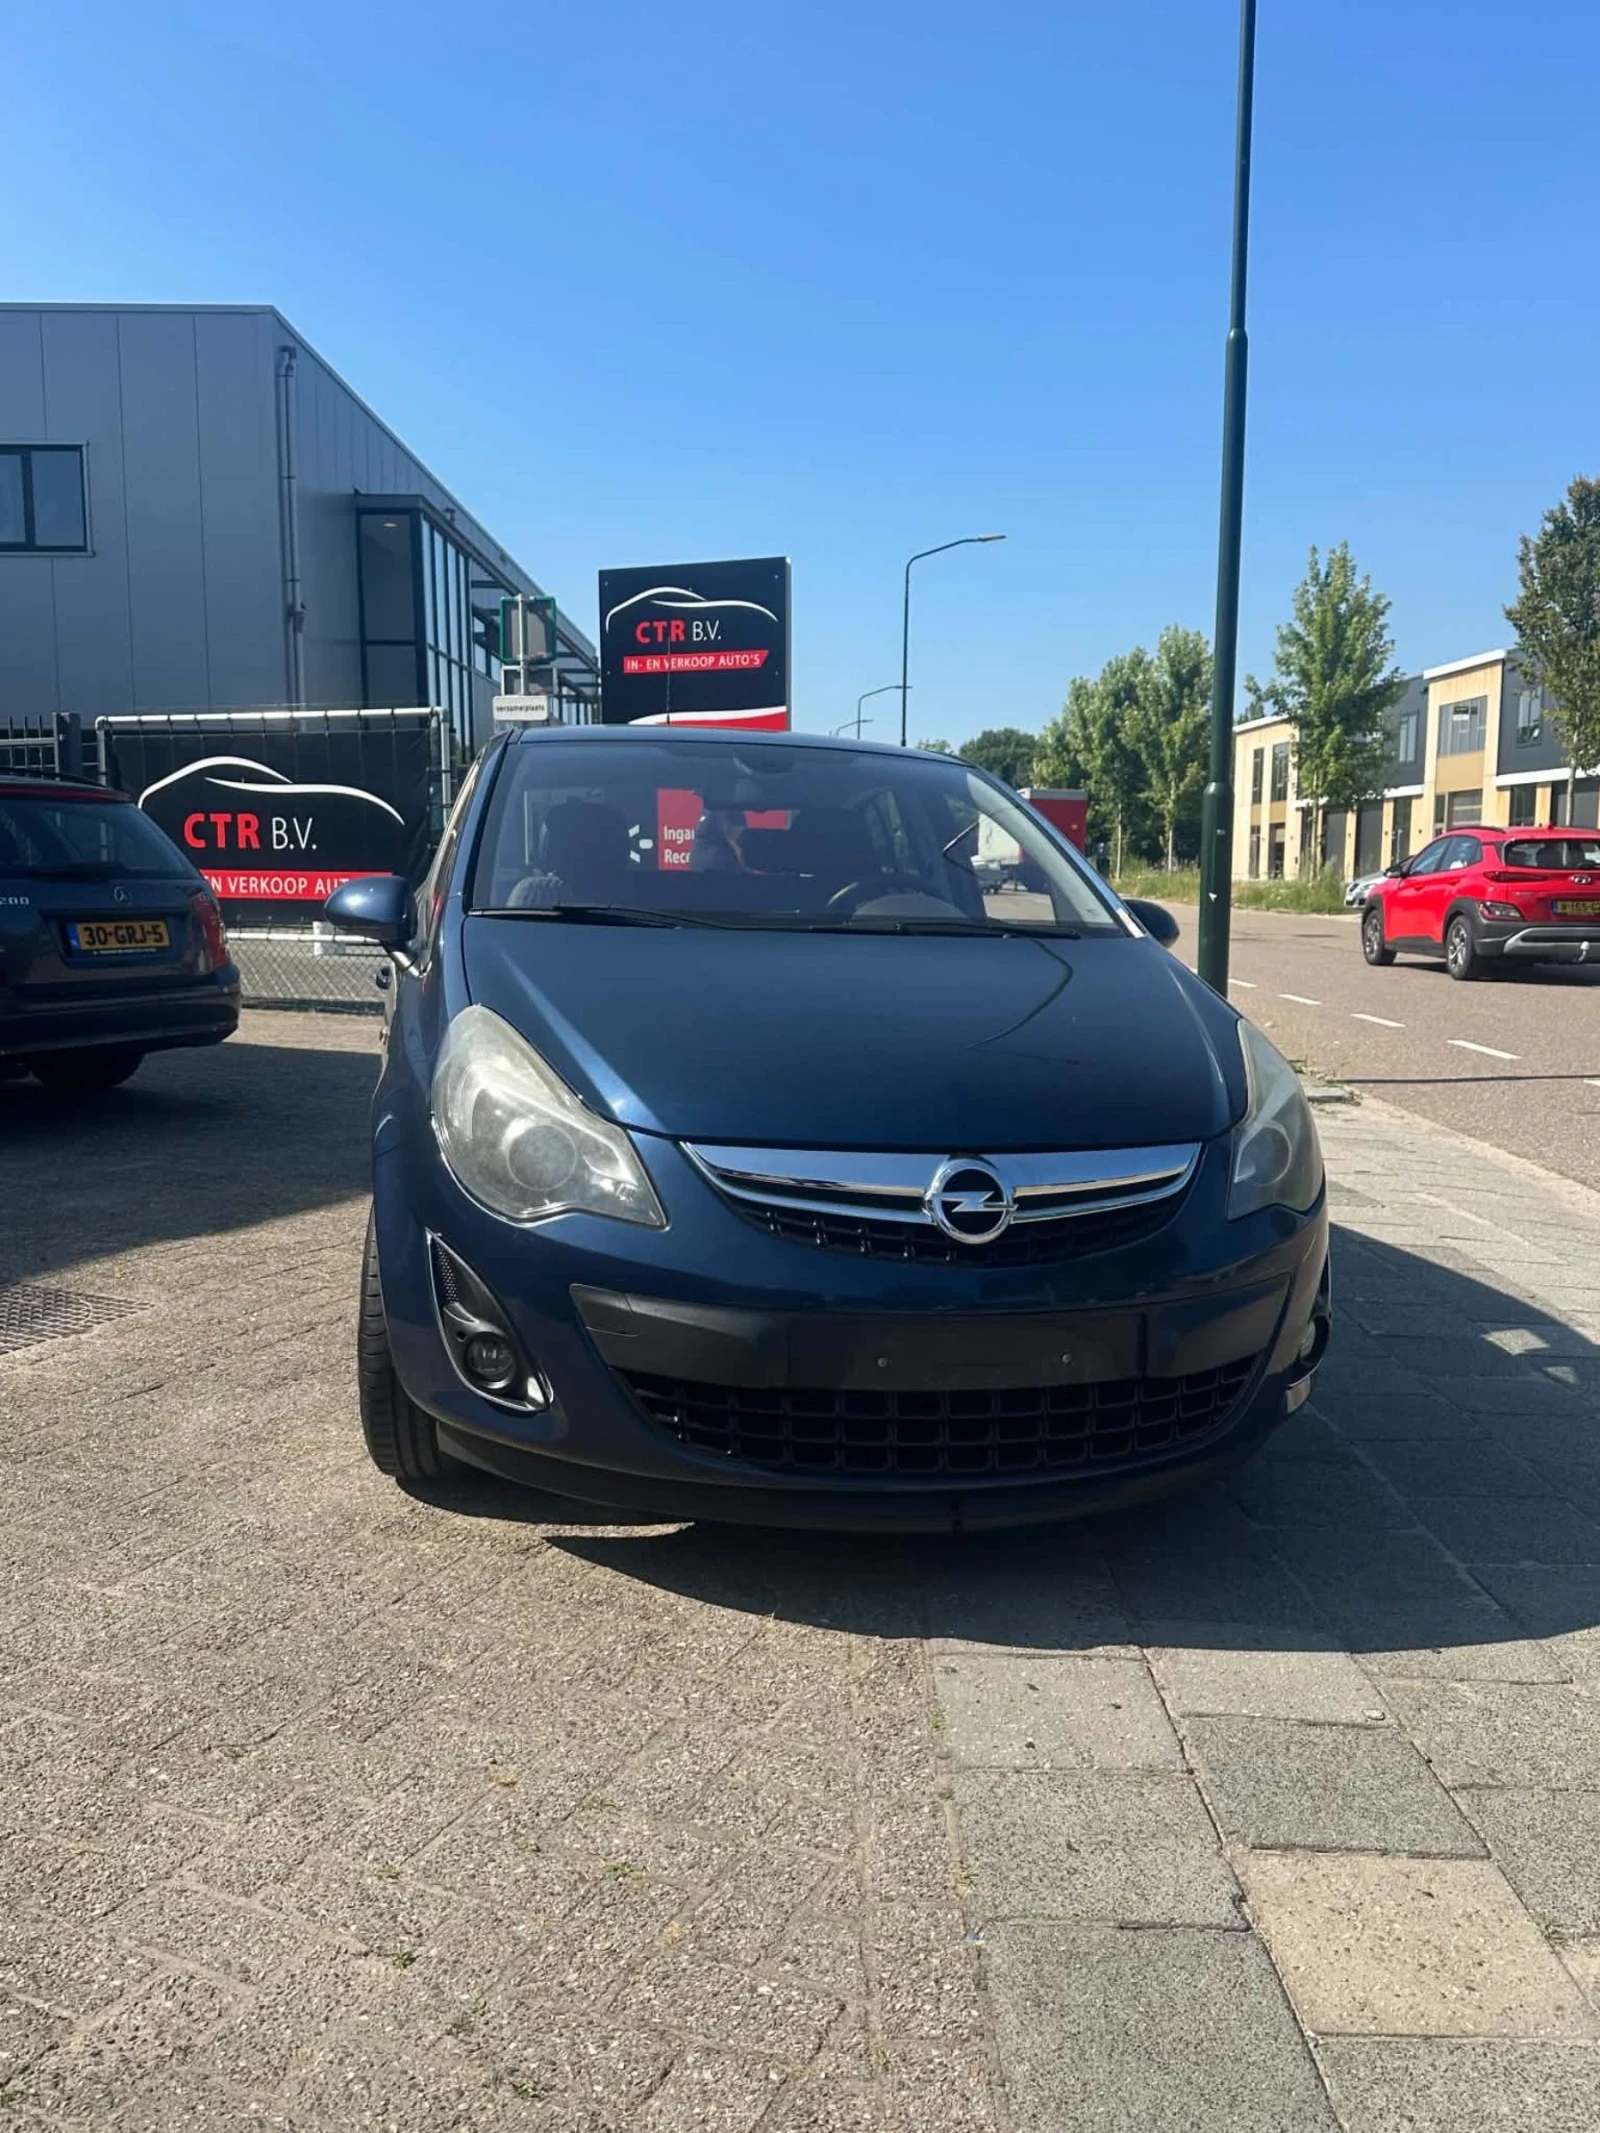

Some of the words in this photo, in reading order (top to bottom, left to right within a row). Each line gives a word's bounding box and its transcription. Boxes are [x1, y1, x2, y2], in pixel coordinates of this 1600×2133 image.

[635, 619, 685, 644] CTR
[692, 620, 722, 641] B.V.
[626, 659, 643, 671] IN-
[646, 658, 661, 670] EN
[664, 655, 715, 670] VERKOOP
[718, 653, 760, 666] AUTO'S
[183, 813, 260, 849] CTR
[271, 816, 317, 850] B.V.
[227, 876, 308, 895] VERKOOP
[83, 924, 164, 947] 30-GRJ-5
